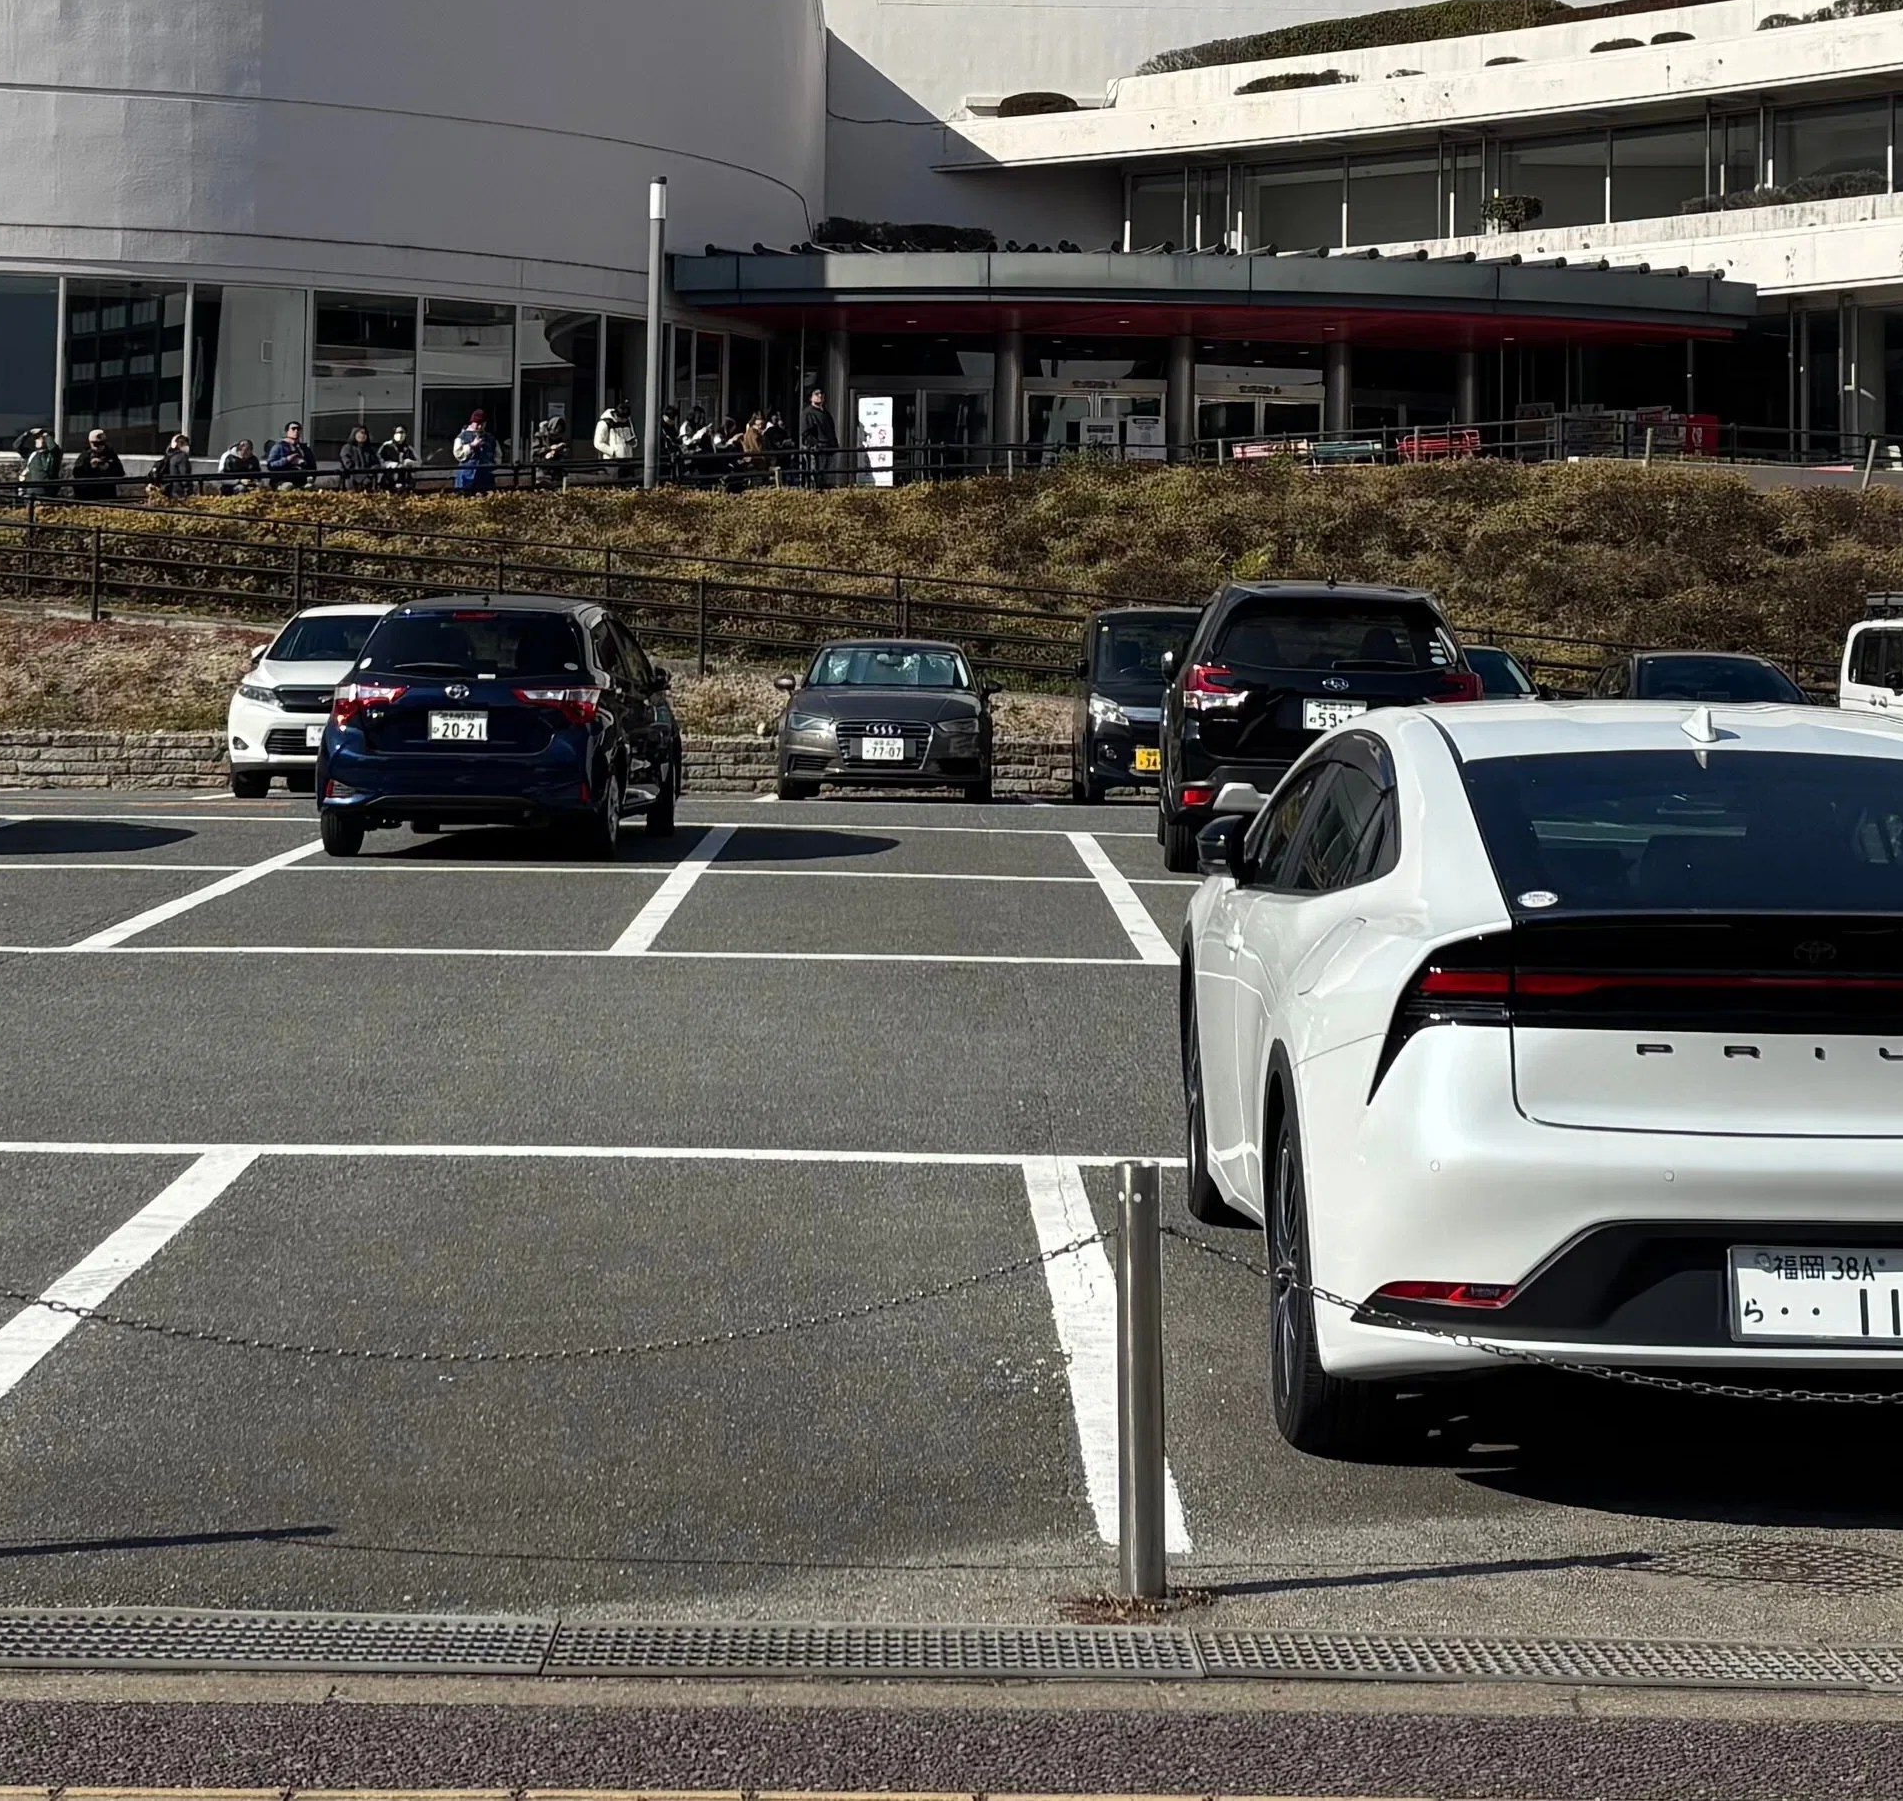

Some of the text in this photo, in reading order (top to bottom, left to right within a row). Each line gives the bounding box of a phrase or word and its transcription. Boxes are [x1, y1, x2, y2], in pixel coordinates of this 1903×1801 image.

[442, 722, 482, 739] 20-21
[1773, 1254, 1876, 1282] 福岡 38A
[1743, 1297, 1765, 1324] ら
